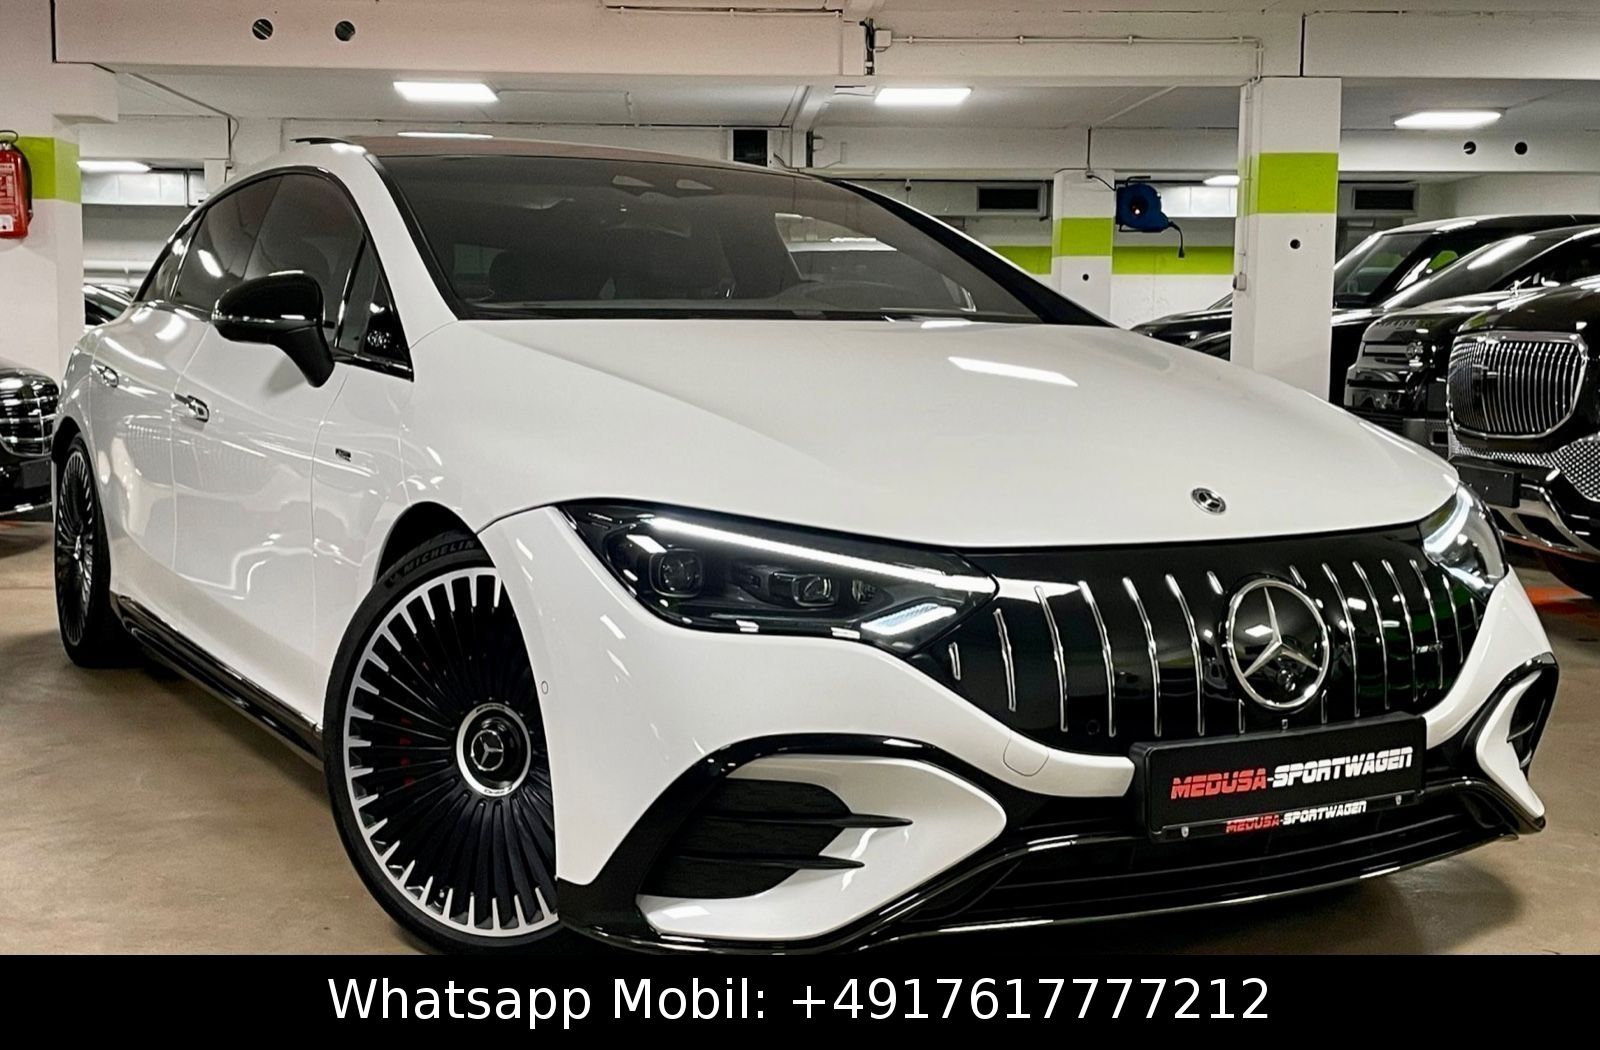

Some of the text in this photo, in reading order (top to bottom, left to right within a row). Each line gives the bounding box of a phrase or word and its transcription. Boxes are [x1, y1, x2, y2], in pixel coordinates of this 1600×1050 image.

[404, 540, 475, 573] MICHELIN
[1170, 746, 1413, 800] MEDUSA-SPORTWAGEN
[1225, 800, 1367, 833] MEDUSA-SPORTWAGEN
